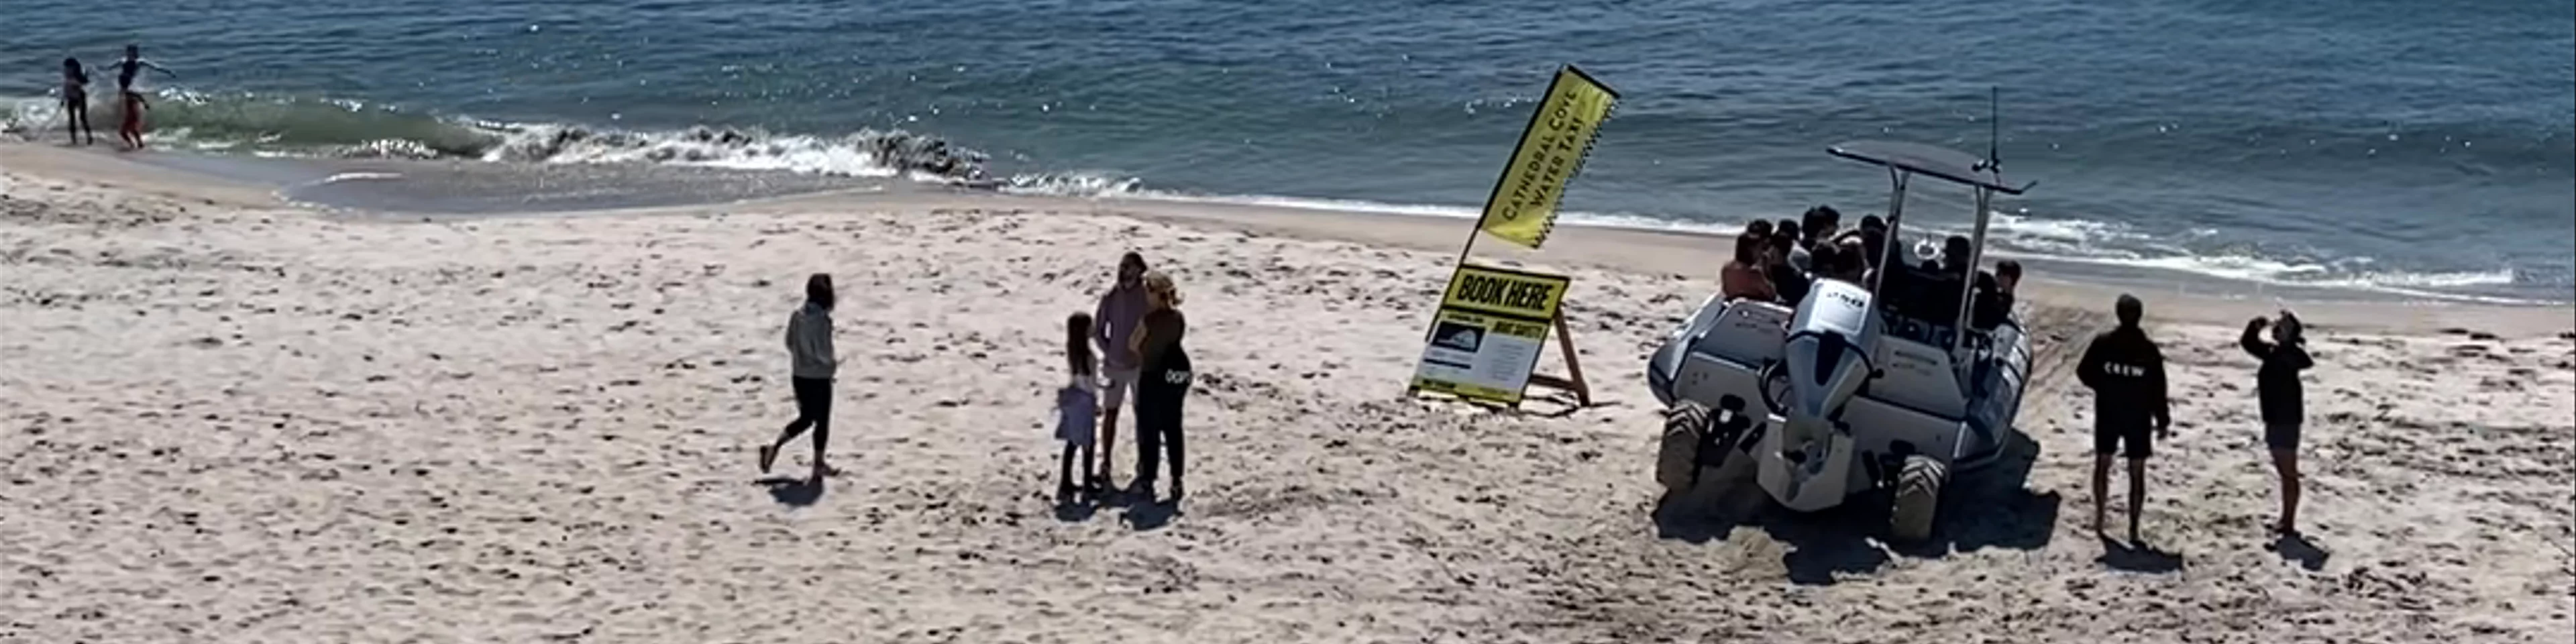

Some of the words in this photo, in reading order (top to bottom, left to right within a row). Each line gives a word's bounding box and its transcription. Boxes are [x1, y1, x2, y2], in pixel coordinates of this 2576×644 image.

[1502, 135, 1556, 220] CATHEDRAL
[1529, 156, 1564, 206] WATER
[1557, 117, 1583, 152] TAXI
[1457, 274, 1509, 305] BOOK
[1504, 280, 1553, 311] HERE
[2104, 361, 2145, 376] CREW
